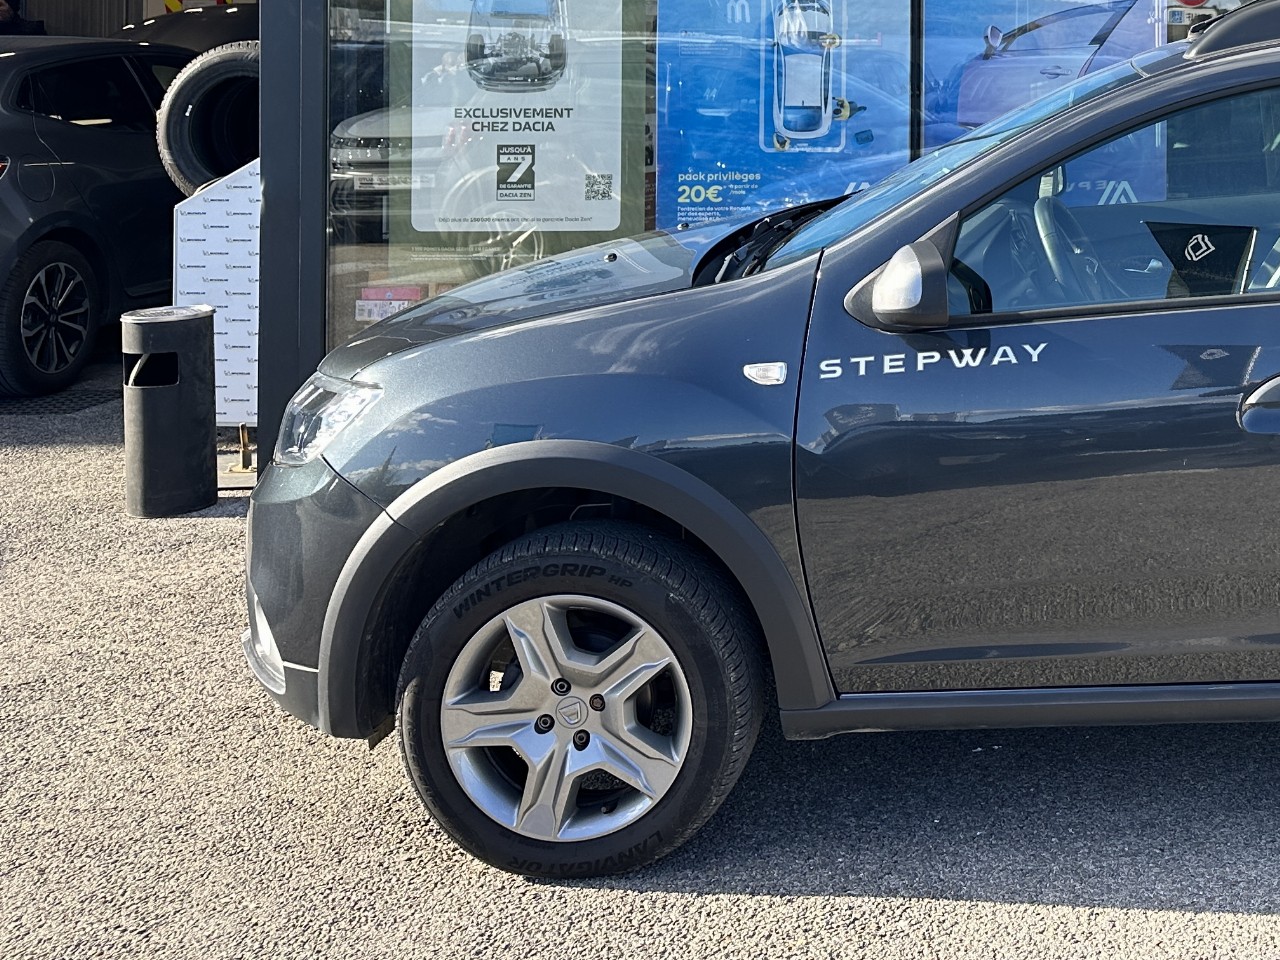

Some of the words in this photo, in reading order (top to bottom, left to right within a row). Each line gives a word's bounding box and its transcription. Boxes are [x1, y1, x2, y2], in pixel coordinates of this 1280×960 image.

[454, 108, 573, 118] EXCLUSIVEMENT
[471, 121, 508, 132] CHEZ
[512, 121, 555, 132] DACIA
[500, 155, 533, 182] 7
[678, 172, 705, 182] pack
[707, 172, 761, 182] privilèges
[818, 342, 1048, 379] STEPWAY
[453, 564, 607, 621] WINTERGRIP
